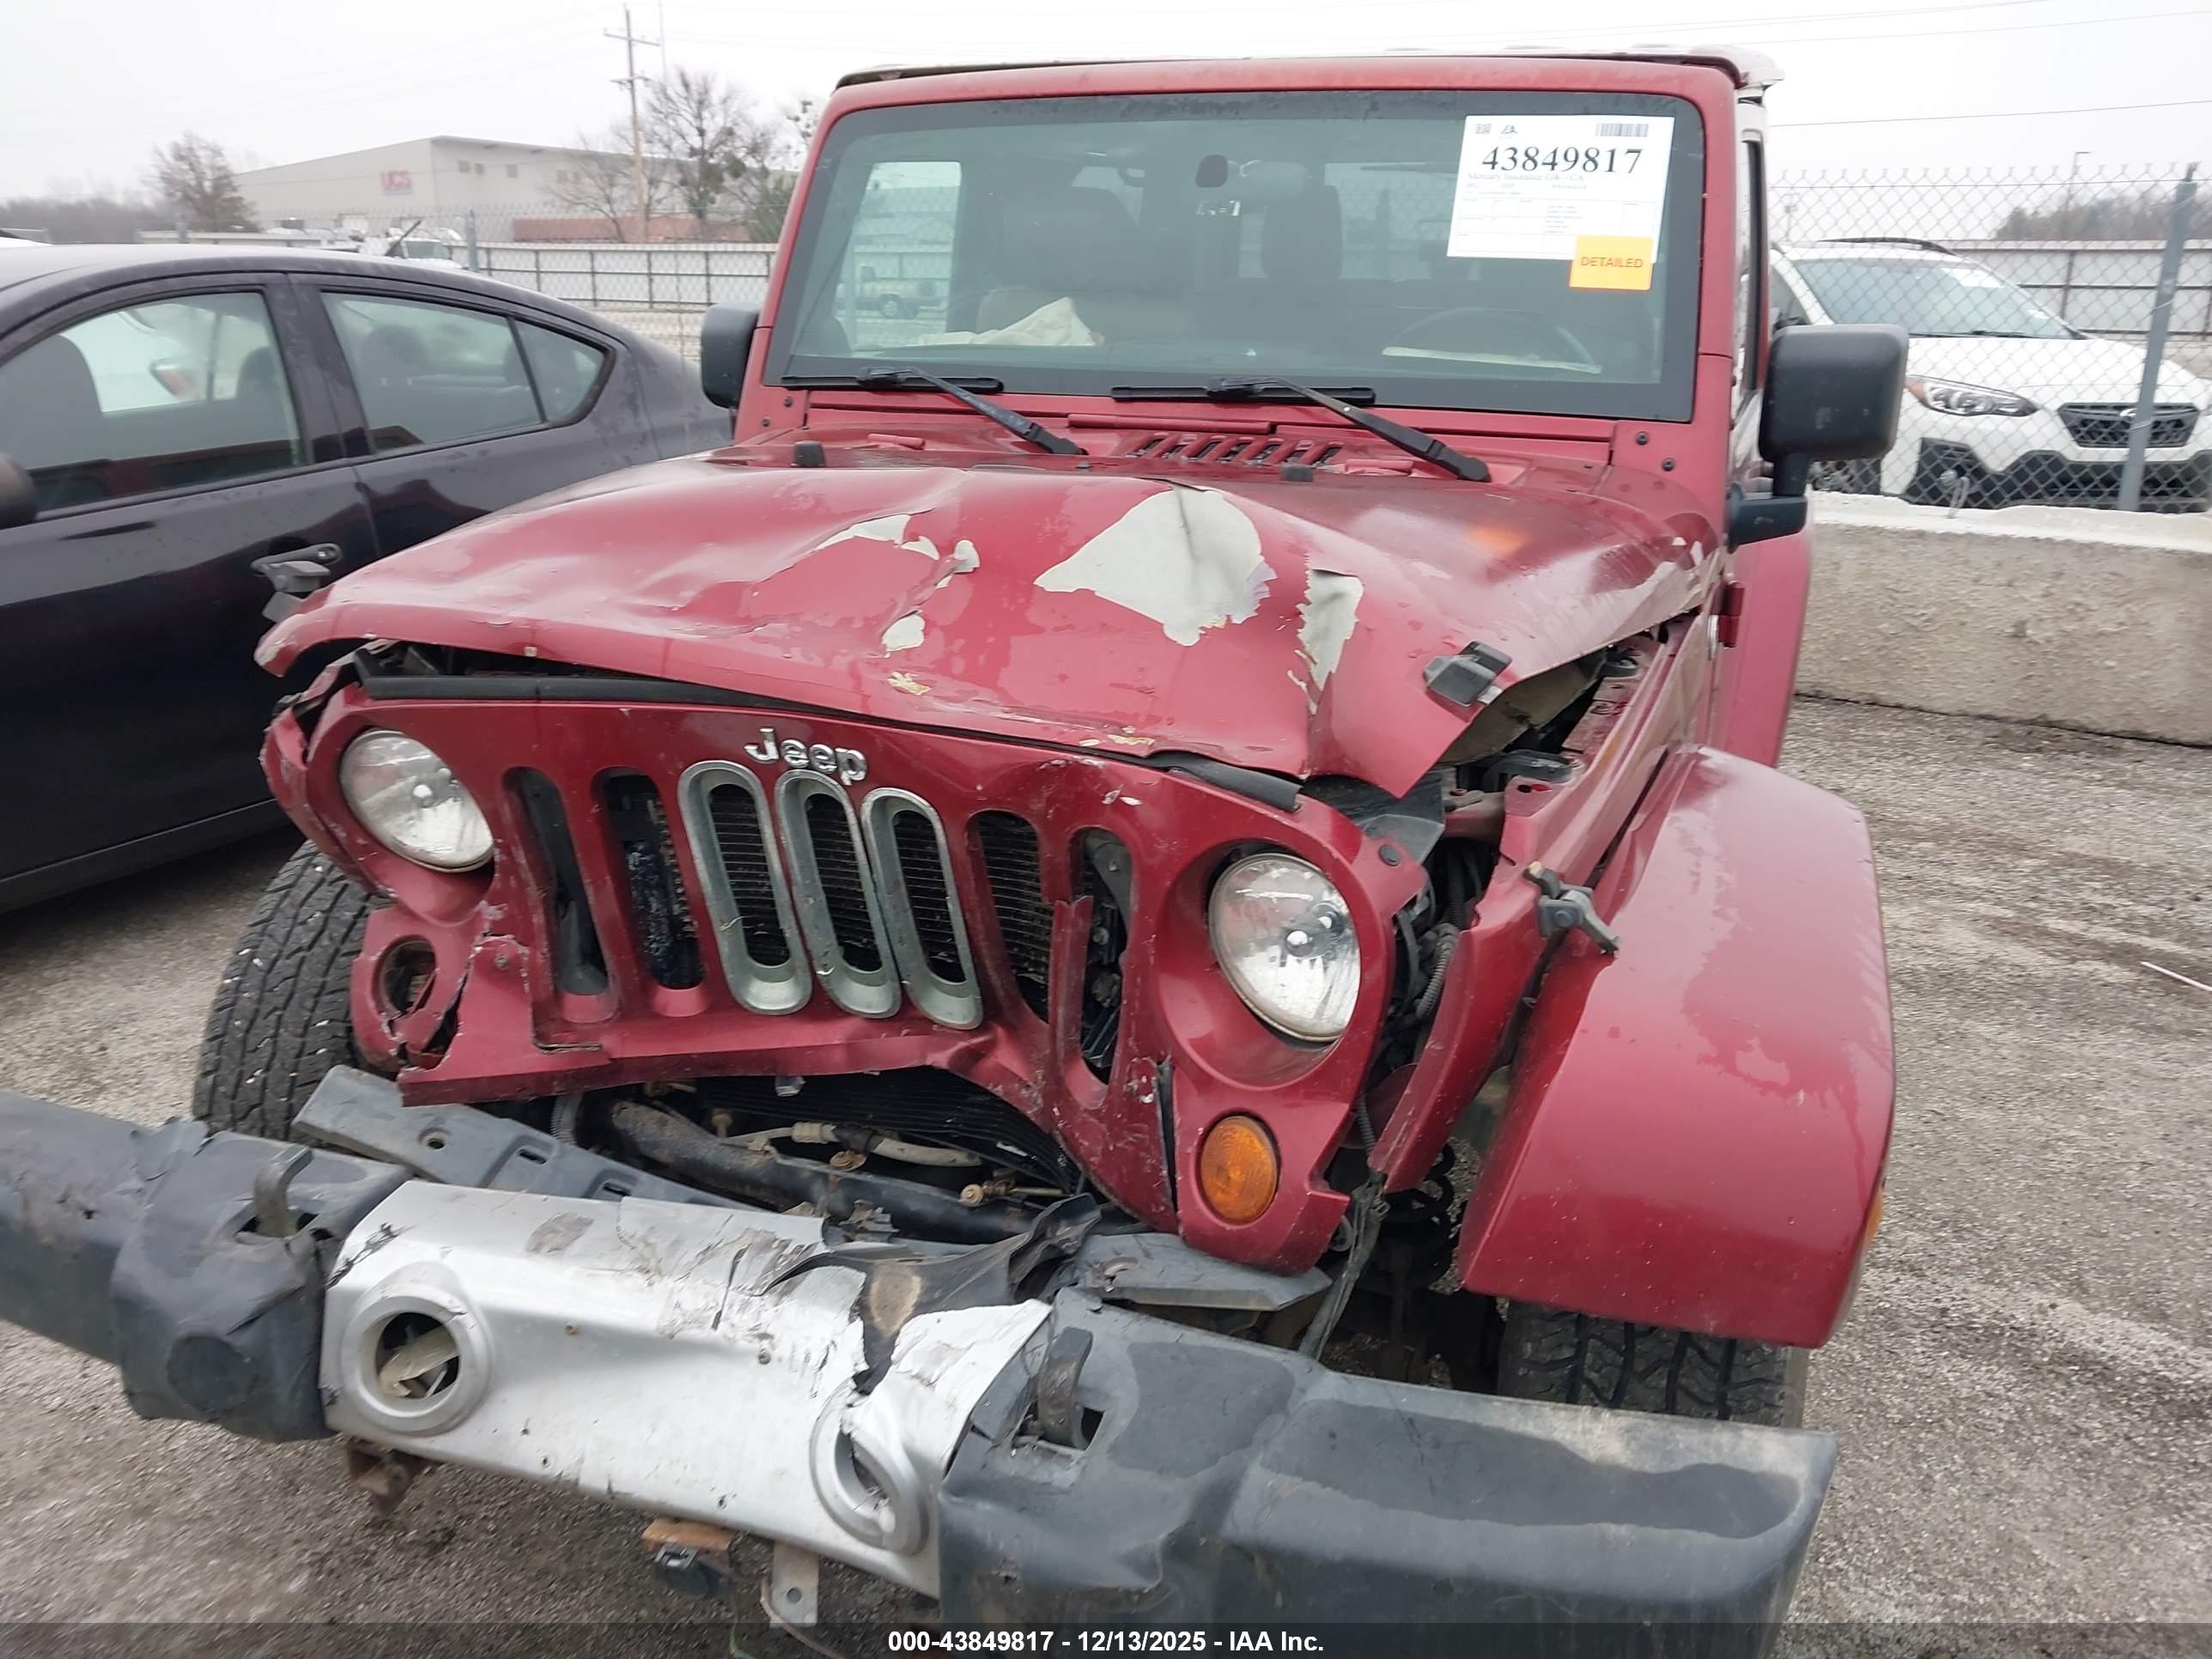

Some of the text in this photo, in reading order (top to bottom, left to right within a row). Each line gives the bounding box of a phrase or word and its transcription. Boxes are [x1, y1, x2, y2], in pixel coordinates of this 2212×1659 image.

[1481, 146, 1643, 173] 43849817
[1580, 256, 1644, 269] DETAILED
[744, 726, 868, 786] Jeep
